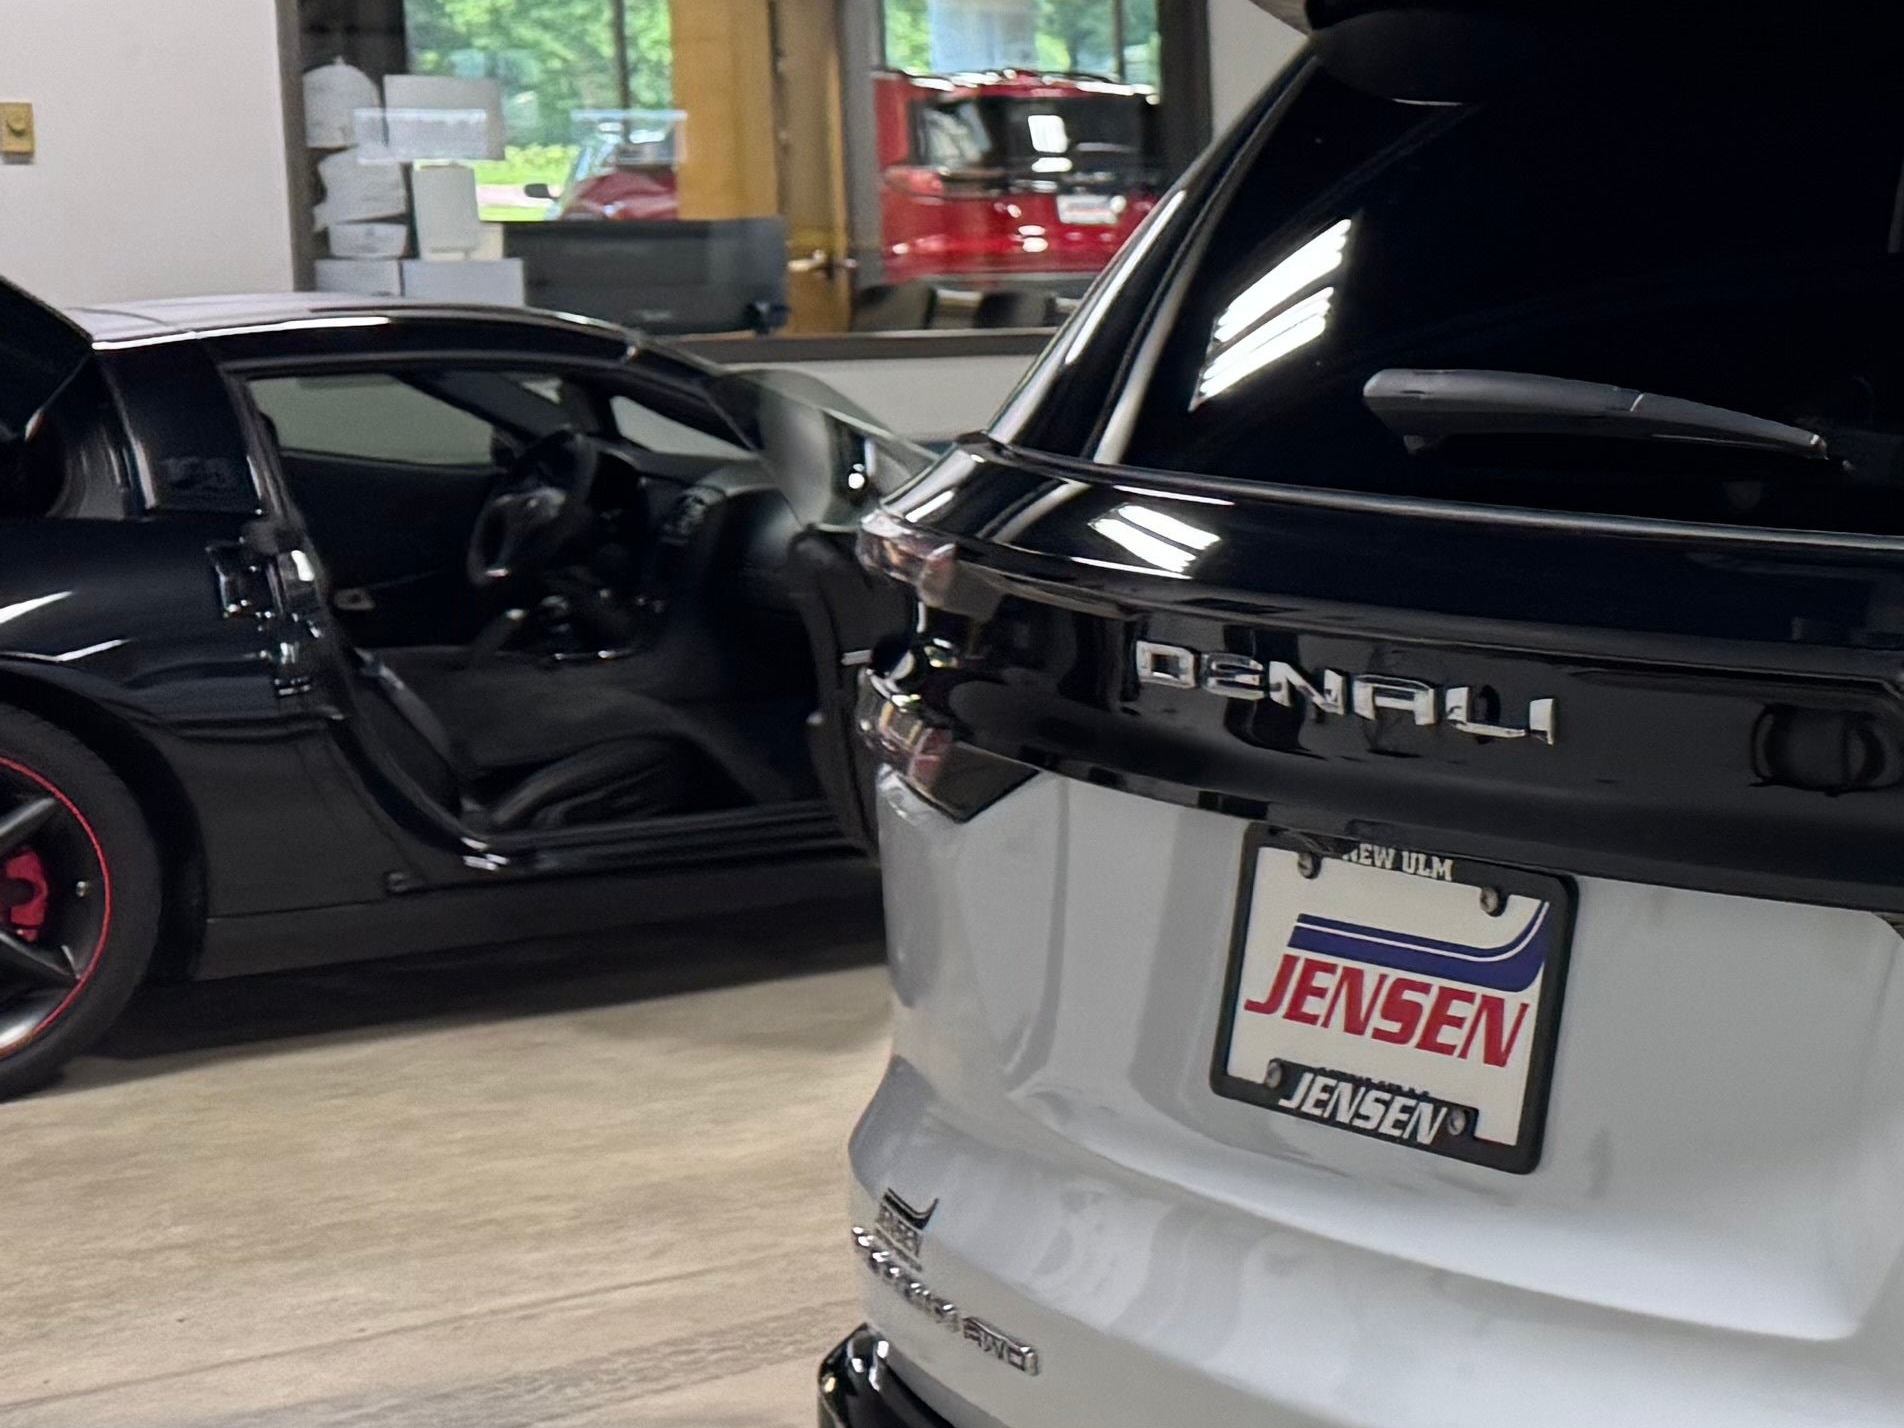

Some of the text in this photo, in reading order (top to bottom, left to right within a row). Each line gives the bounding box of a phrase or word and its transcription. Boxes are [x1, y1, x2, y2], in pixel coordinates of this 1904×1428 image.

[1135, 639, 1557, 746] DENALI
[1401, 850, 1453, 882] ULM
[1243, 953, 1530, 1069] JENSEN
[1278, 1072, 1448, 1145] JENSEN
[962, 1316, 1040, 1376] AWD
